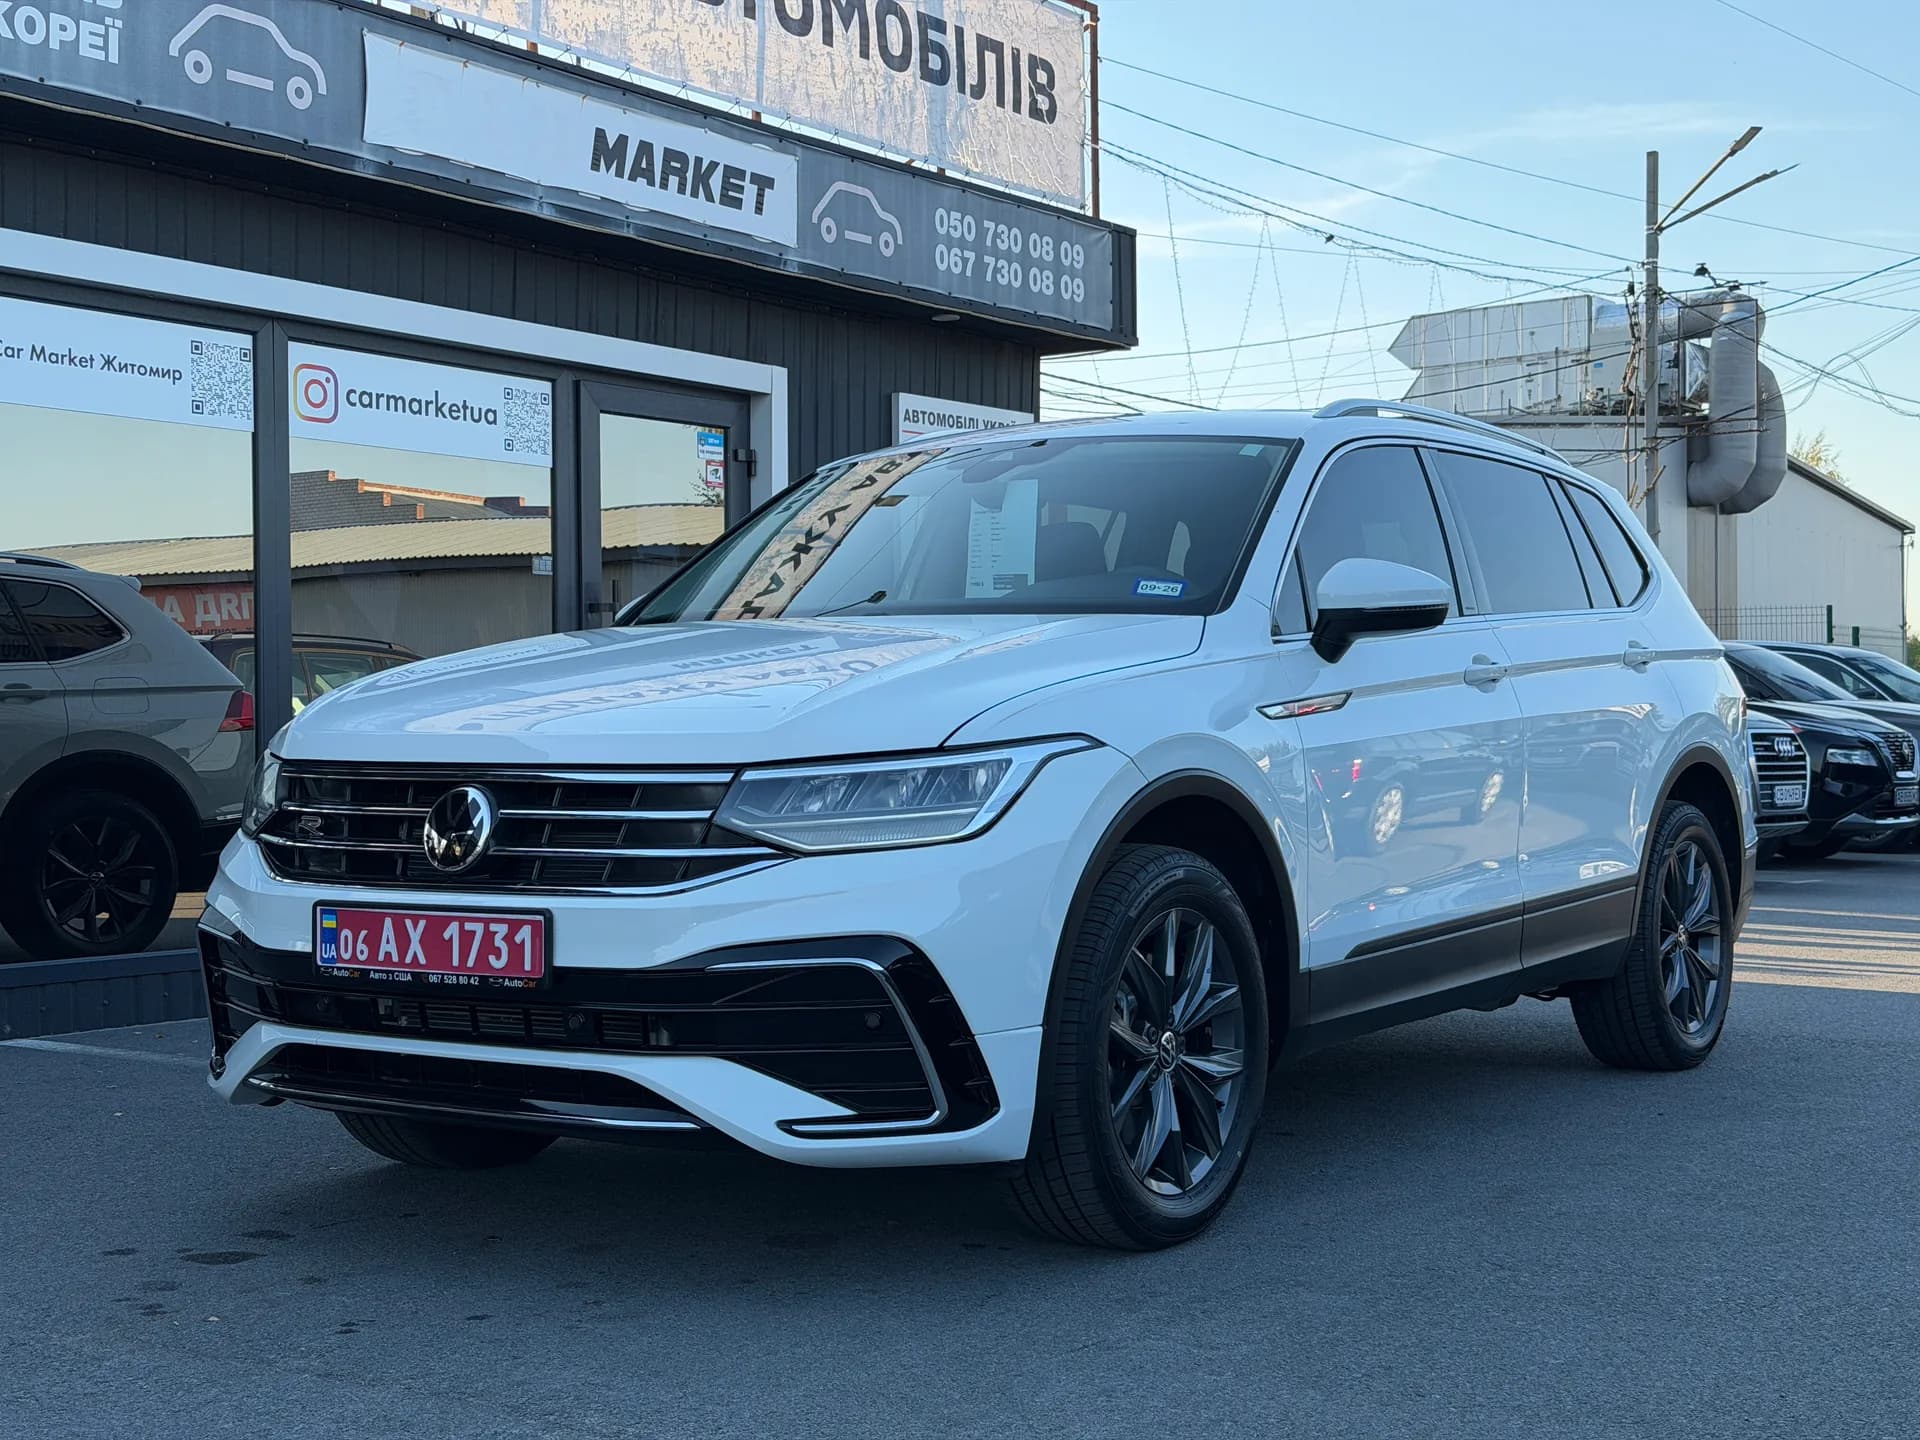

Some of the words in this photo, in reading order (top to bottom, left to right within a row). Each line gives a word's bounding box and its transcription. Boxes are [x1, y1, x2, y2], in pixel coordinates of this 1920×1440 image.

[590, 127, 776, 216] MARKET
[934, 207, 977, 243] 050
[983, 219, 1023, 254] 730
[1028, 232, 1054, 262] 08
[1060, 240, 1085, 270] 09
[934, 243, 976, 277] 067
[983, 255, 1023, 289] 730
[1028, 266, 1054, 296] 08
[1060, 274, 1085, 303] 09
[29, 344, 96, 370] Market
[100, 353, 183, 385] Житомир
[345, 388, 498, 426] carmarketua
[903, 408, 979, 430] АВТОМОБІЛІ
[321, 943, 338, 959] UA
[339, 928, 369, 962] 06
[442, 921, 532, 972] 1731
[332, 968, 360, 979] AutoCar
[369, 970, 386, 980] Авто
[394, 971, 412, 982] США
[428, 974, 442, 984] 067
[443, 975, 458, 985] 528
[459, 976, 469, 985] 80
[469, 976, 480, 986] 42
[503, 979, 537, 988] AutoCar
